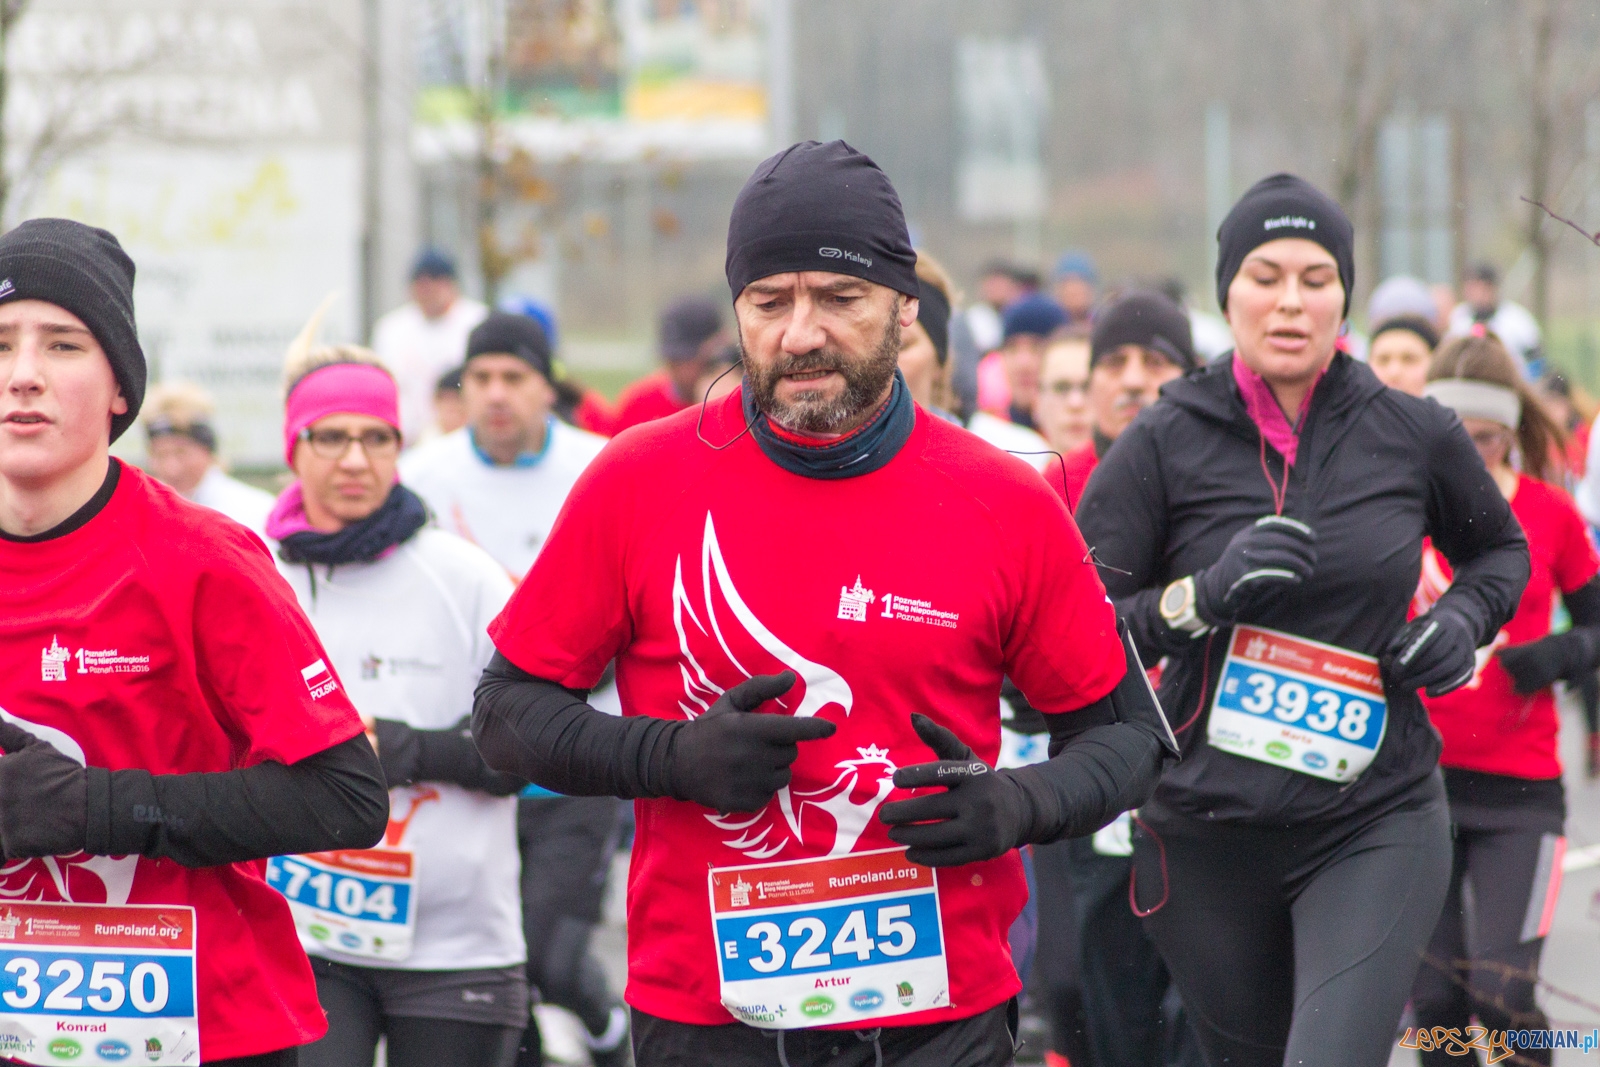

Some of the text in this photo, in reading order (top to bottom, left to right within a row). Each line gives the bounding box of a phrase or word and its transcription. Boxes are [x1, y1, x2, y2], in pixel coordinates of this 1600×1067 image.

[844, 249, 873, 268] Kalenji
[881, 593, 932, 619] 1 Poznański
[892, 602, 909, 613] Bieg
[75, 647, 88, 674] 1
[310, 680, 338, 701] POLSKA
[1225, 672, 1371, 741] E 3938
[937, 765, 971, 777] Kalenji
[829, 867, 918, 888] RunPoland.org
[283, 860, 397, 920] 7104
[94, 923, 179, 940] RunPoland.org
[724, 903, 917, 974] E 3245
[2, 956, 170, 1014] 3250
[814, 976, 852, 989] Artur
[805, 1002, 833, 1014] energy
[56, 1021, 107, 1033] Konrad
[52, 1045, 80, 1057] energy
